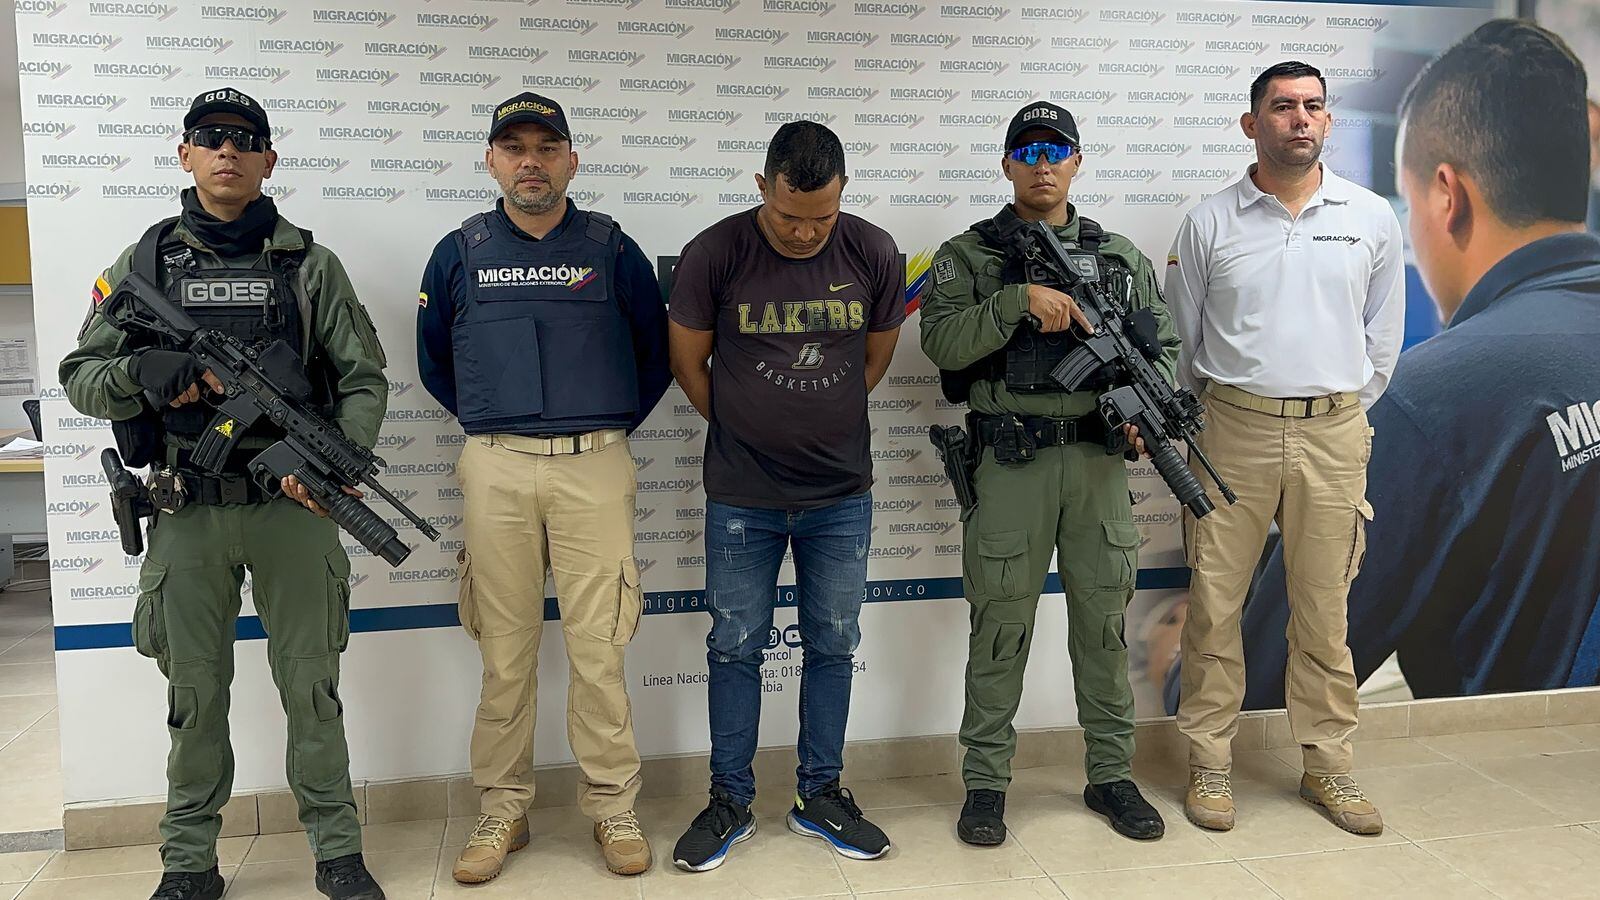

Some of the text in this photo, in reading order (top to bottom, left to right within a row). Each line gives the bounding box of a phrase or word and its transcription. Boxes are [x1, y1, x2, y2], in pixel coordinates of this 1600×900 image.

[16, 0, 56, 11] ACIÓN
[90, 2, 167, 15] MIGRACIÓN
[763, 0, 828, 11] MIGRACIÓN
[854, 2, 917, 14] MIGRACIÓN
[941, 4, 1002, 16] MIGRACIÓN
[201, 5, 277, 19] MIGRACIÓN
[313, 9, 387, 22] MIGRACIÓN
[1021, 7, 1082, 18] MIGRACIÓN
[1099, 9, 1159, 21] MIGRACIÓN
[1176, 11, 1234, 23] MIGRACIÓN
[417, 13, 489, 26] MIGRACIÓN
[520, 17, 589, 30] MIGRACIÓN
[1252, 14, 1308, 25] MIGRACIÓN
[618, 21, 685, 34] MIGRACIÓN
[33, 32, 112, 46] MIGRACIÓN
[715, 28, 781, 40] MIGRACIÓN
[807, 30, 871, 42] MIGRACIÓN
[891, 32, 953, 44] MIGRACIÓN
[972, 34, 1033, 46] MIGRACIÓN
[146, 35, 223, 48] MIGRACIÓN
[259, 39, 334, 52] MIGRACIÓN
[1051, 36, 1111, 47] MIGRACIÓN
[1129, 38, 1188, 49] MIGRACIÓN
[1205, 40, 1262, 51] MIGRACIÓN
[1281, 42, 1336, 53] MIGRACIÓN
[365, 42, 437, 55] MIGRACIÓN
[469, 45, 539, 58] MIGRACIÓN
[568, 49, 637, 62] MIGRACIÓN
[667, 53, 733, 65] MIGRACIÓN
[764, 55, 828, 67] MIGRACIÓN
[19, 60, 61, 72] ACIÓN
[94, 62, 171, 75] MIGRACIÓN
[854, 57, 917, 69] MIGRACIÓN
[940, 59, 1002, 71] MIGRACIÓN
[1020, 60, 1081, 72] MIGRACIÓN
[1098, 62, 1157, 73] MIGRACIÓN
[1175, 63, 1233, 74] MIGRACIÓN
[205, 65, 281, 78] MIGRACIÓN
[316, 68, 390, 81] MIGRACIÓN
[420, 71, 492, 84] MIGRACIÓN
[522, 75, 591, 87] MIGRACIÓN
[620, 78, 687, 90] MIGRACIÓN
[716, 83, 781, 96] MIGRACIÓN
[808, 85, 871, 97] MIGRACIÓN
[890, 87, 952, 98] MIGRACIÓN
[971, 88, 1032, 99] MIGRACIÓN
[1050, 89, 1109, 100] MIGRACIÓN
[1128, 90, 1186, 101] MIGRACIÓN
[38, 93, 116, 106] MIGRACIÓN
[150, 97, 192, 107] MIGRA
[205, 91, 250, 106] GOES
[368, 100, 440, 113] MIGRACIÓN
[498, 101, 550, 117] MIGRACIÓN
[571, 106, 638, 118] MIGRACIÓN
[668, 108, 734, 121] MIGRACIÓN
[854, 112, 917, 124] MIGRACIÓN
[939, 113, 1001, 124] MIGRACIÓN
[1023, 108, 1058, 121] GOES
[1097, 114, 1156, 125] MIGRACIÓN
[1174, 115, 1231, 126] MIGRACIÓN
[23, 121, 65, 133] ACIÓN
[98, 122, 175, 135] MIGRACIÓN
[319, 126, 393, 139] MIGRACIÓN
[423, 129, 489, 141] MIGRACIÓ
[622, 134, 688, 146] MIGRACIÓN
[890, 141, 951, 152] MIGRACIÓN
[971, 143, 1004, 152] MIGRA
[1126, 142, 1184, 153] MIGRACIÓN
[1202, 143, 1255, 153] MIGRACIÓ
[42, 153, 121, 166] MIGRACIÓN
[277, 155, 340, 168] IGRACIÓN
[371, 158, 443, 170] MIGRACIÓN
[670, 165, 735, 177] MIGRACIÓN
[854, 167, 916, 179] MIGRACIÓN
[939, 167, 1000, 179] MIGRACIÓN
[1095, 167, 1154, 178] MIGRACIÓN
[1172, 167, 1229, 178] MIGRACIÓN
[27, 183, 70, 195] ACIÓN
[323, 185, 396, 197] MIGRACIÓN
[623, 191, 689, 202] MIGRACIÓN
[718, 194, 764, 203] MIGRAC
[890, 192, 951, 204] MIGRACIÓN
[970, 195, 1013, 203] MIGRAC
[1068, 194, 1107, 203] RACIÓN
[1125, 192, 1183, 203] MIGRACIÓN
[478, 264, 583, 282] MIGRACIÓN
[1030, 259, 1094, 280] GS
[188, 282, 267, 301] GOES
[738, 300, 864, 333] LAKERS
[756, 361, 852, 391] BASKETBALL
[889, 374, 940, 385] MIGRACIÓ
[868, 399, 914, 409] GRACIÓN
[58, 417, 112, 427] MIGRAC
[889, 426, 930, 435] MIGRAC
[44, 443, 85, 455] ACIÓN
[1561, 443, 1600, 472] MINISTE
[385, 461, 456, 474] MIGRACIÓN
[63, 474, 108, 484] MIGRA
[48, 500, 89, 512] ACIÓN
[874, 499, 914, 509] RACIÓN
[387, 514, 457, 526] MIGACIÓN
[1132, 512, 1176, 522] GRACIÓN
[889, 521, 948, 532] MIGRACIÓN
[66, 530, 119, 541] MIGRAC
[868, 546, 914, 556] GRACIÓN
[52, 556, 93, 569] ACIÓN
[389, 567, 458, 581] MIGRACIÓN
[70, 583, 139, 597] MIGRACIÓ
[643, 674, 673, 686] Línea
[677, 672, 708, 684] Nacio
